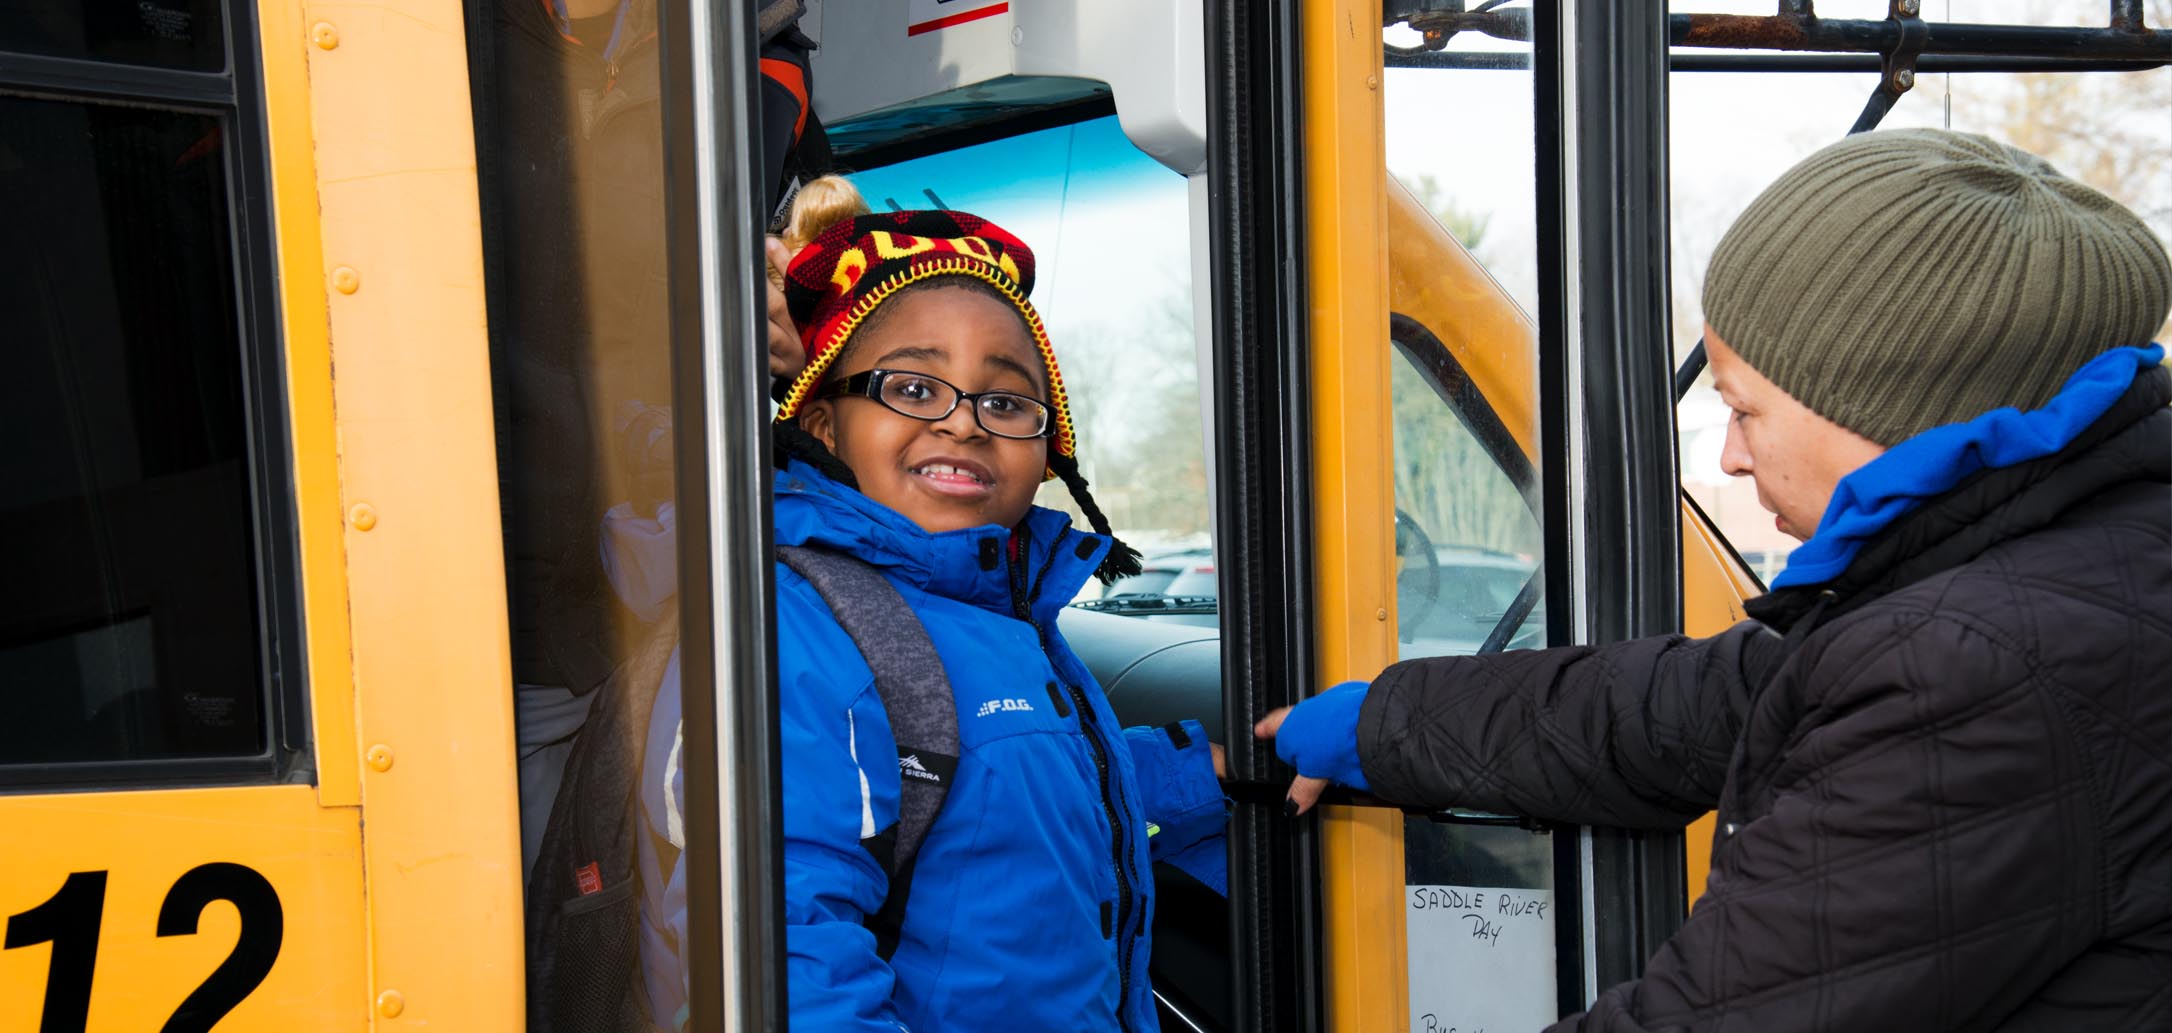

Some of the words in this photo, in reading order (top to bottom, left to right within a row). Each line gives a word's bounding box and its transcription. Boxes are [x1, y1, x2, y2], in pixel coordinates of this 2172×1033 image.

[905, 768, 940, 782] SIERRA
[1412, 887, 1485, 910] SADDLE
[4, 862, 284, 1033] 12
